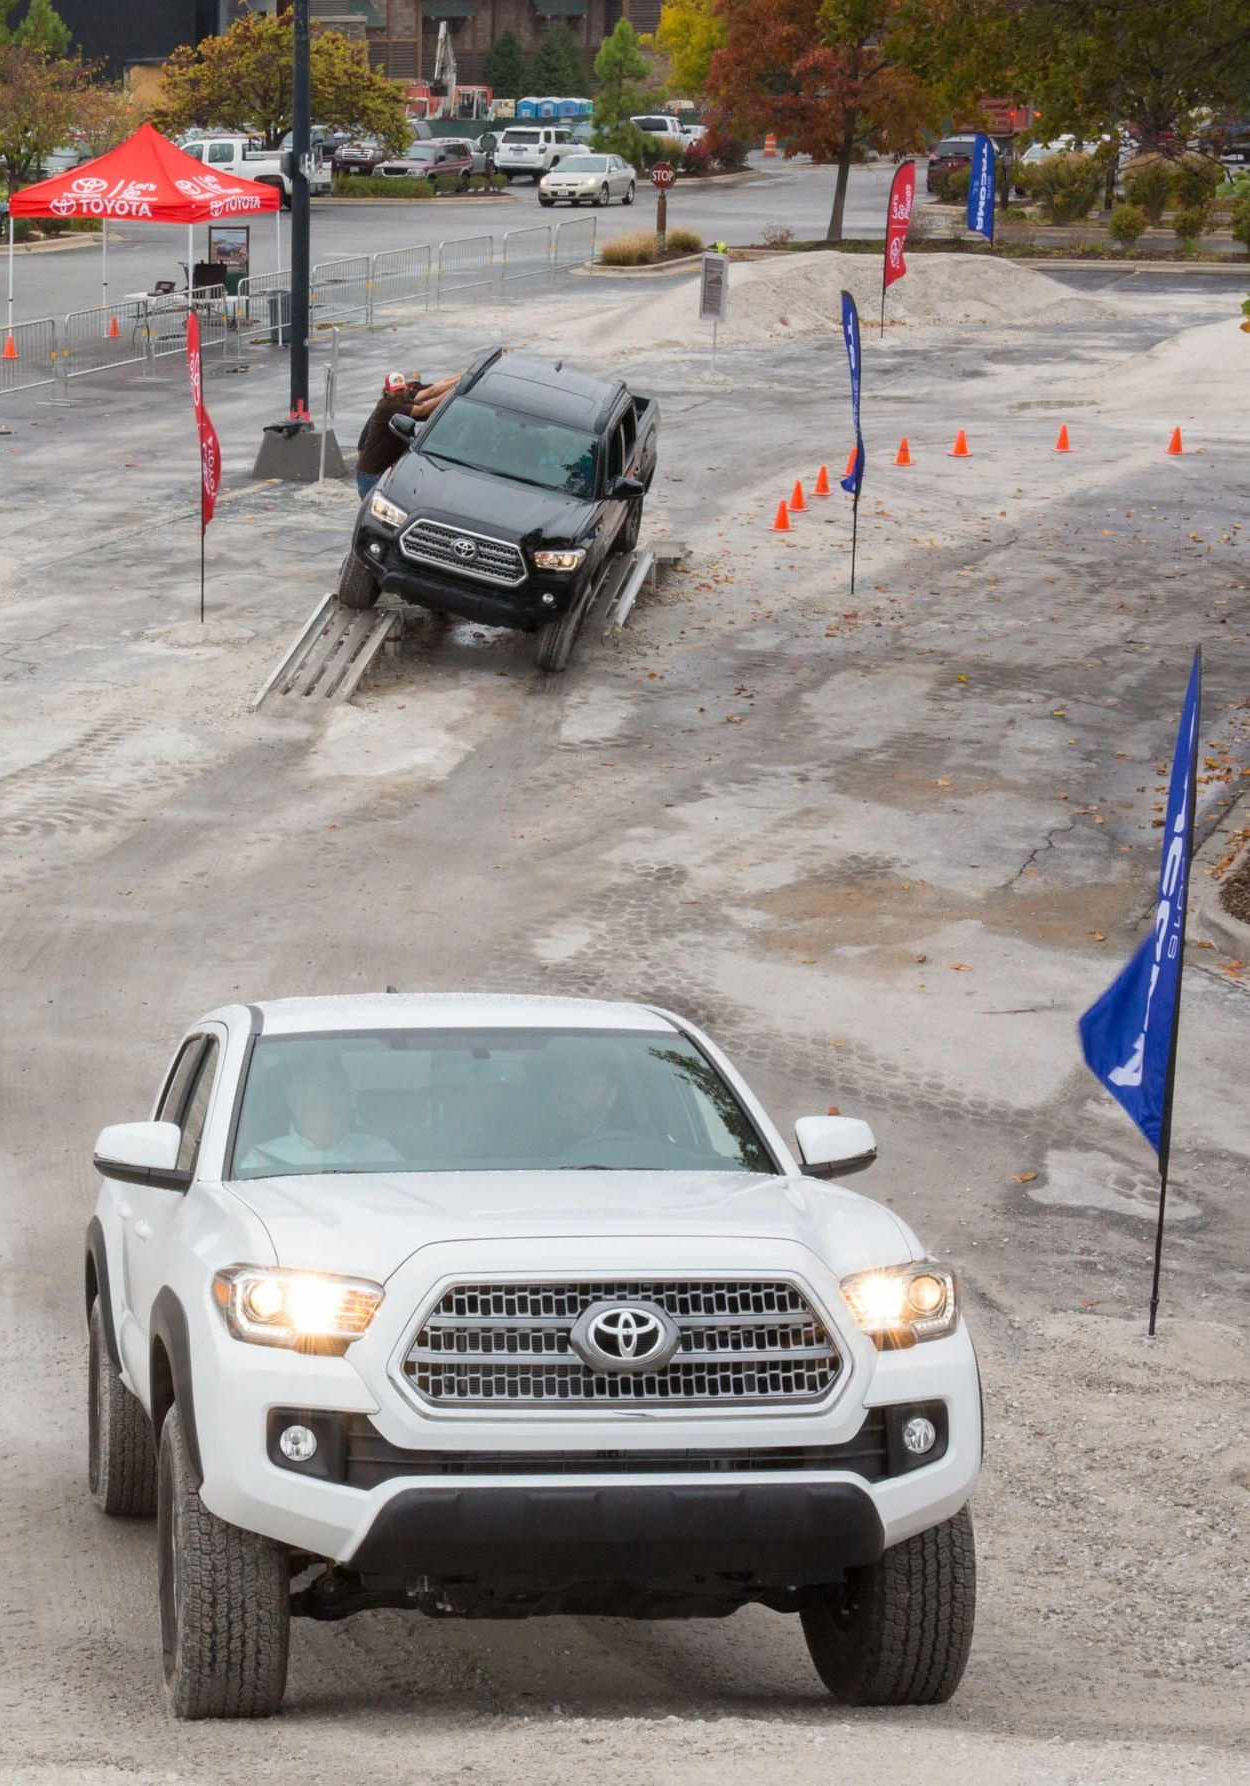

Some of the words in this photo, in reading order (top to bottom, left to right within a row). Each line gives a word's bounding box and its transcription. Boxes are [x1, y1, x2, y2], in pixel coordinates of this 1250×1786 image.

[652, 170, 674, 181] STOP
[976, 142, 988, 231] TACOMA
[79, 199, 152, 217] TOYOTA
[224, 196, 261, 212] TOYOTA
[904, 184, 912, 219] Places
[897, 204, 906, 220] Go
[207, 436, 216, 500] TOYOTA
